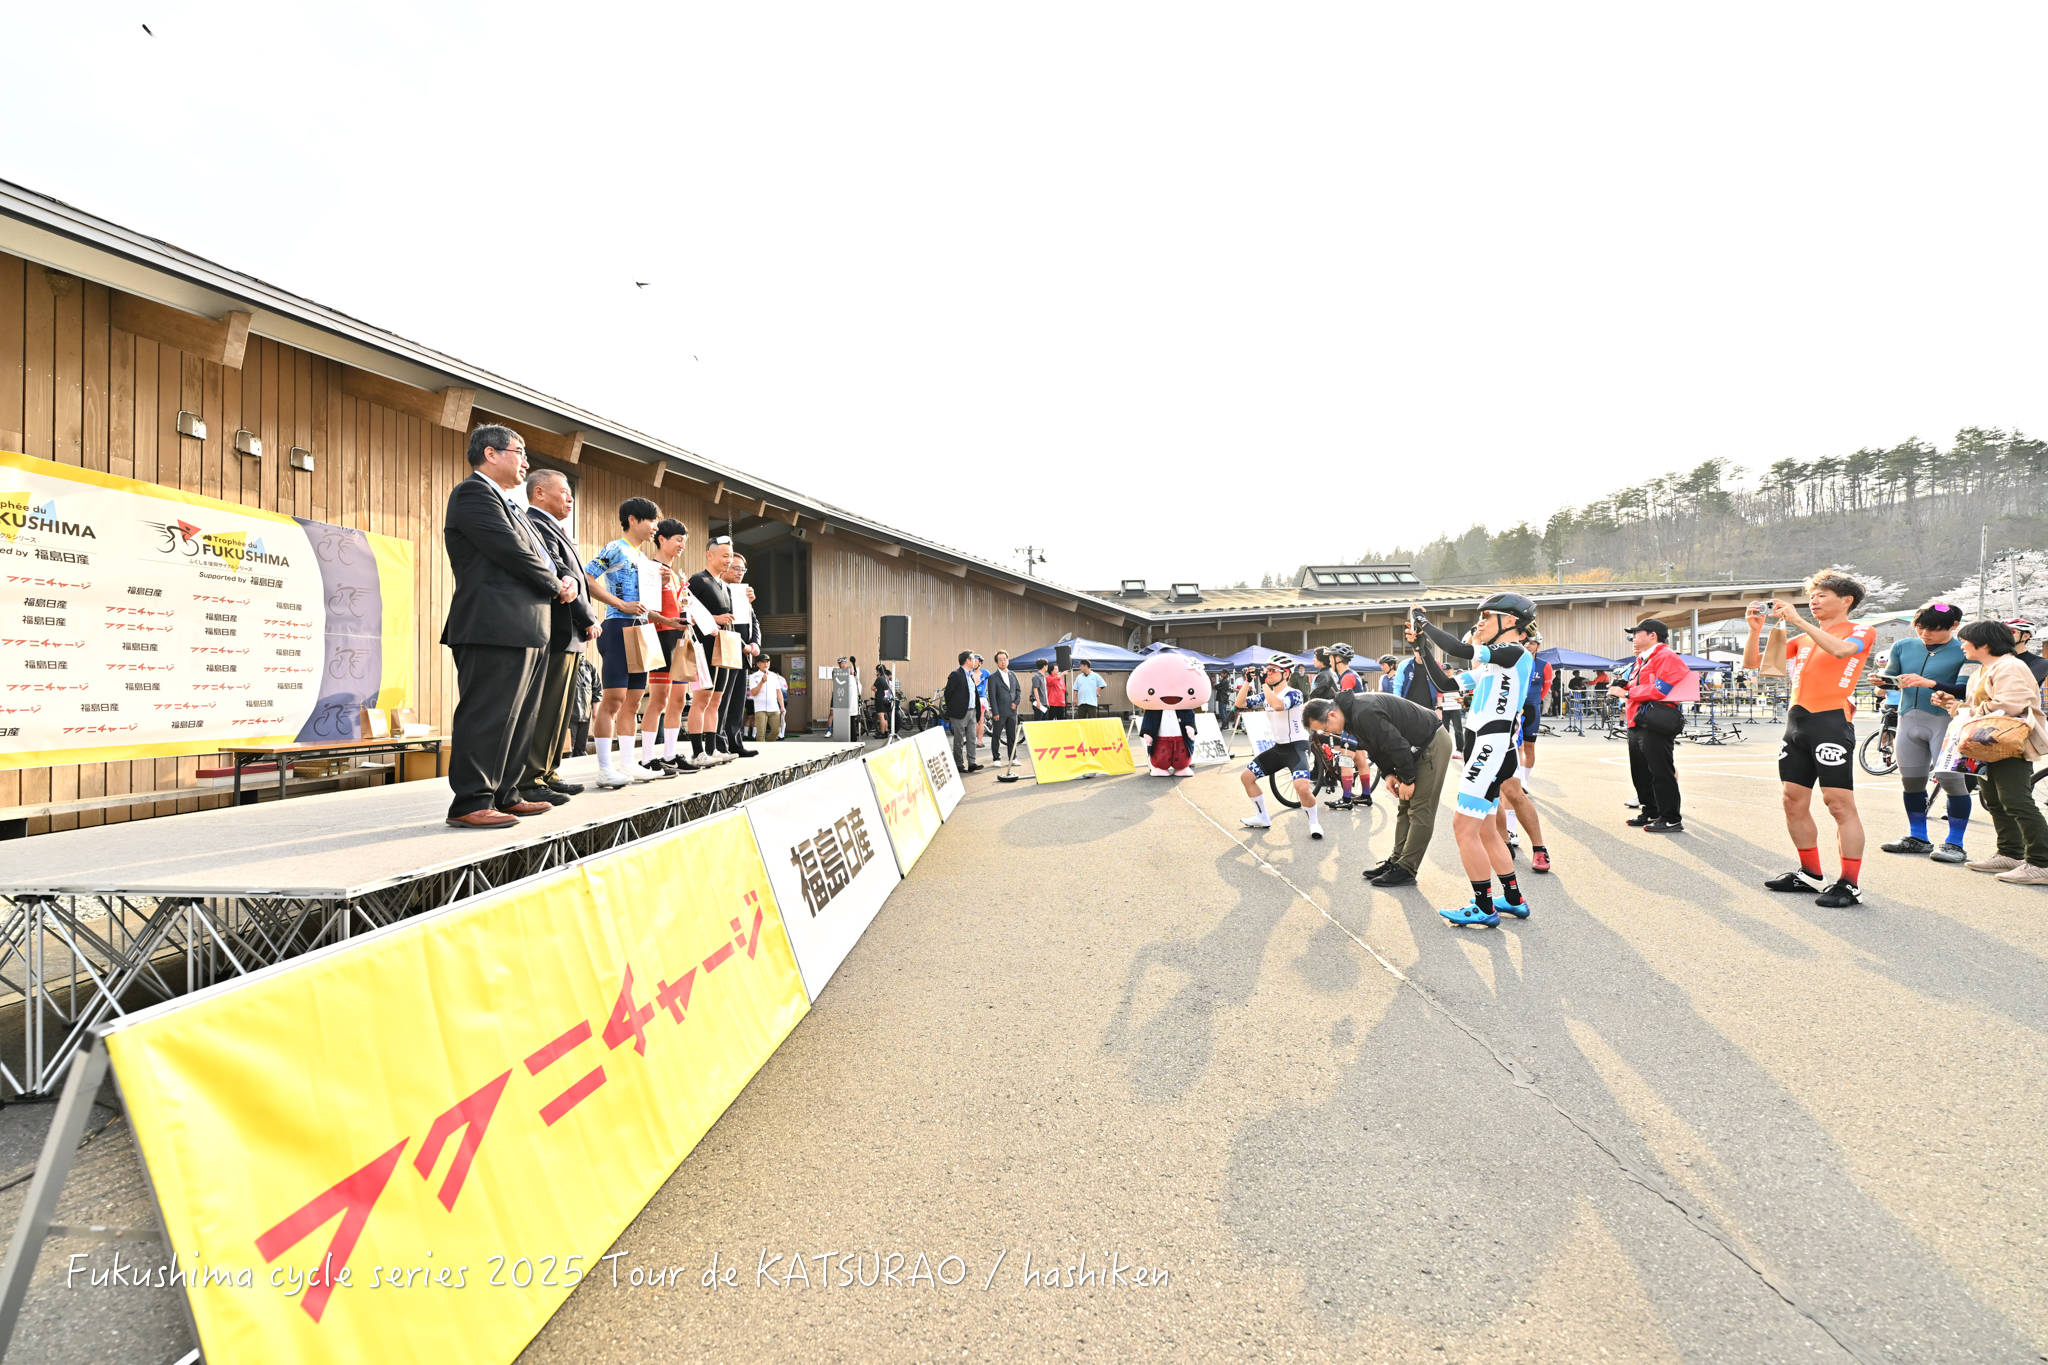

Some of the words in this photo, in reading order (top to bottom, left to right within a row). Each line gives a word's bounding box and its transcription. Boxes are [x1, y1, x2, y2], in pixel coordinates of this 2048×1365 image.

[33, 505, 47, 514] du
[213, 535, 246, 547] Trophée
[248, 541, 258, 549] du
[15, 548, 29, 557] by
[34, 548, 90, 565] 福島日産
[202, 543, 290, 568] FUKUSHIMA
[199, 571, 236, 582] Supported
[7, 576, 91, 590] フクニチャージ
[250, 575, 283, 589] 福島日産
[127, 586, 162, 597] 福島日産
[23, 597, 67, 609] 福島日産
[193, 595, 250, 605] フクニチャージ
[106, 606, 174, 617] フクニチャージ
[22, 615, 66, 626] 福島日産
[205, 613, 237, 622] 福島日産
[105, 623, 173, 632] フクニチャージ
[205, 627, 236, 636] 福島日産
[2, 639, 85, 648] フクニチャージ
[122, 642, 158, 651] 福島日産
[25, 660, 68, 669] 福島日産
[106, 663, 174, 671] フクニチャージ
[206, 664, 237, 672] 福島日産
[1838, 657, 1859, 688] ROAD-RO
[6, 683, 89, 691] フクニチャージ
[81, 703, 119, 712] 福島日産
[154, 702, 216, 710] フクニチャージ
[171, 720, 204, 729] 福島日産
[232, 717, 284, 725] フクニチャージ
[63, 723, 137, 734] フクニチャージ
[1034, 737, 1124, 761] フクニチャージ
[790, 807, 875, 918] 福島日産
[254, 890, 763, 1324] フクニチャージ
